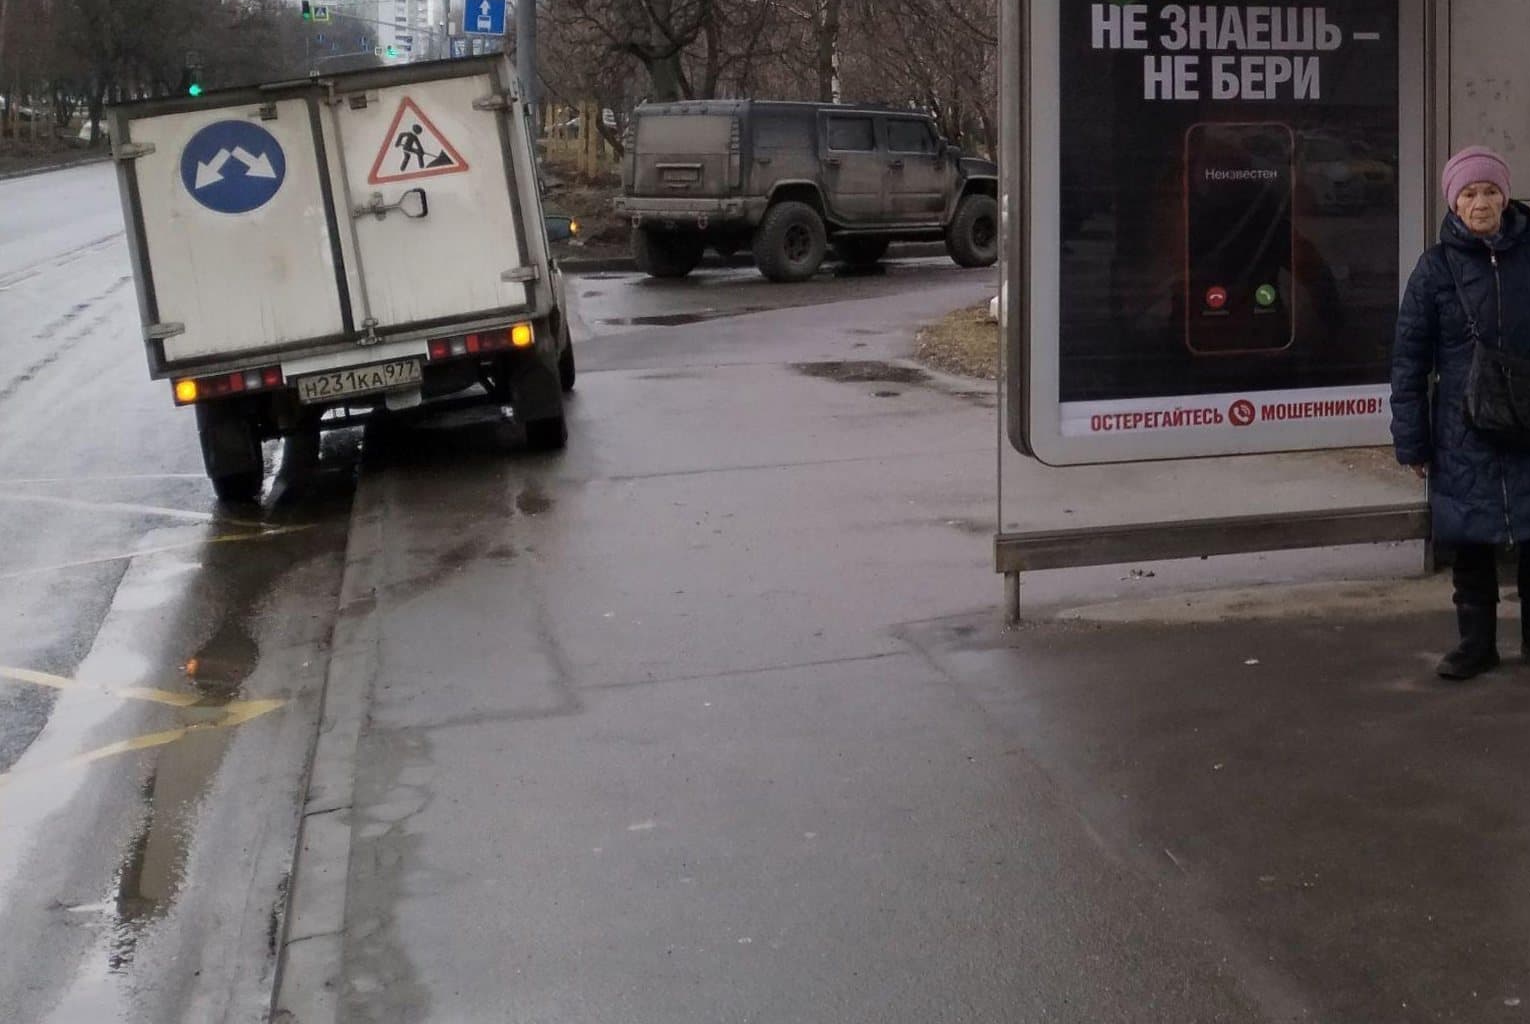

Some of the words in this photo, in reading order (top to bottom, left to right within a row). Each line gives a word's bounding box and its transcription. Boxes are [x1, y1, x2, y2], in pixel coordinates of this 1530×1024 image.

[1091, 4, 1148, 49] НЕ
[1160, 4, 1342, 51] ЗНАЕШЬ
[1144, 56, 1199, 100] НЕ
[1211, 56, 1320, 100] БЕРИ
[1091, 407, 1223, 432] ОСТЕРЕГАЙТЕСЬ
[1261, 398, 1383, 422] МОШЕННИКОВ!
